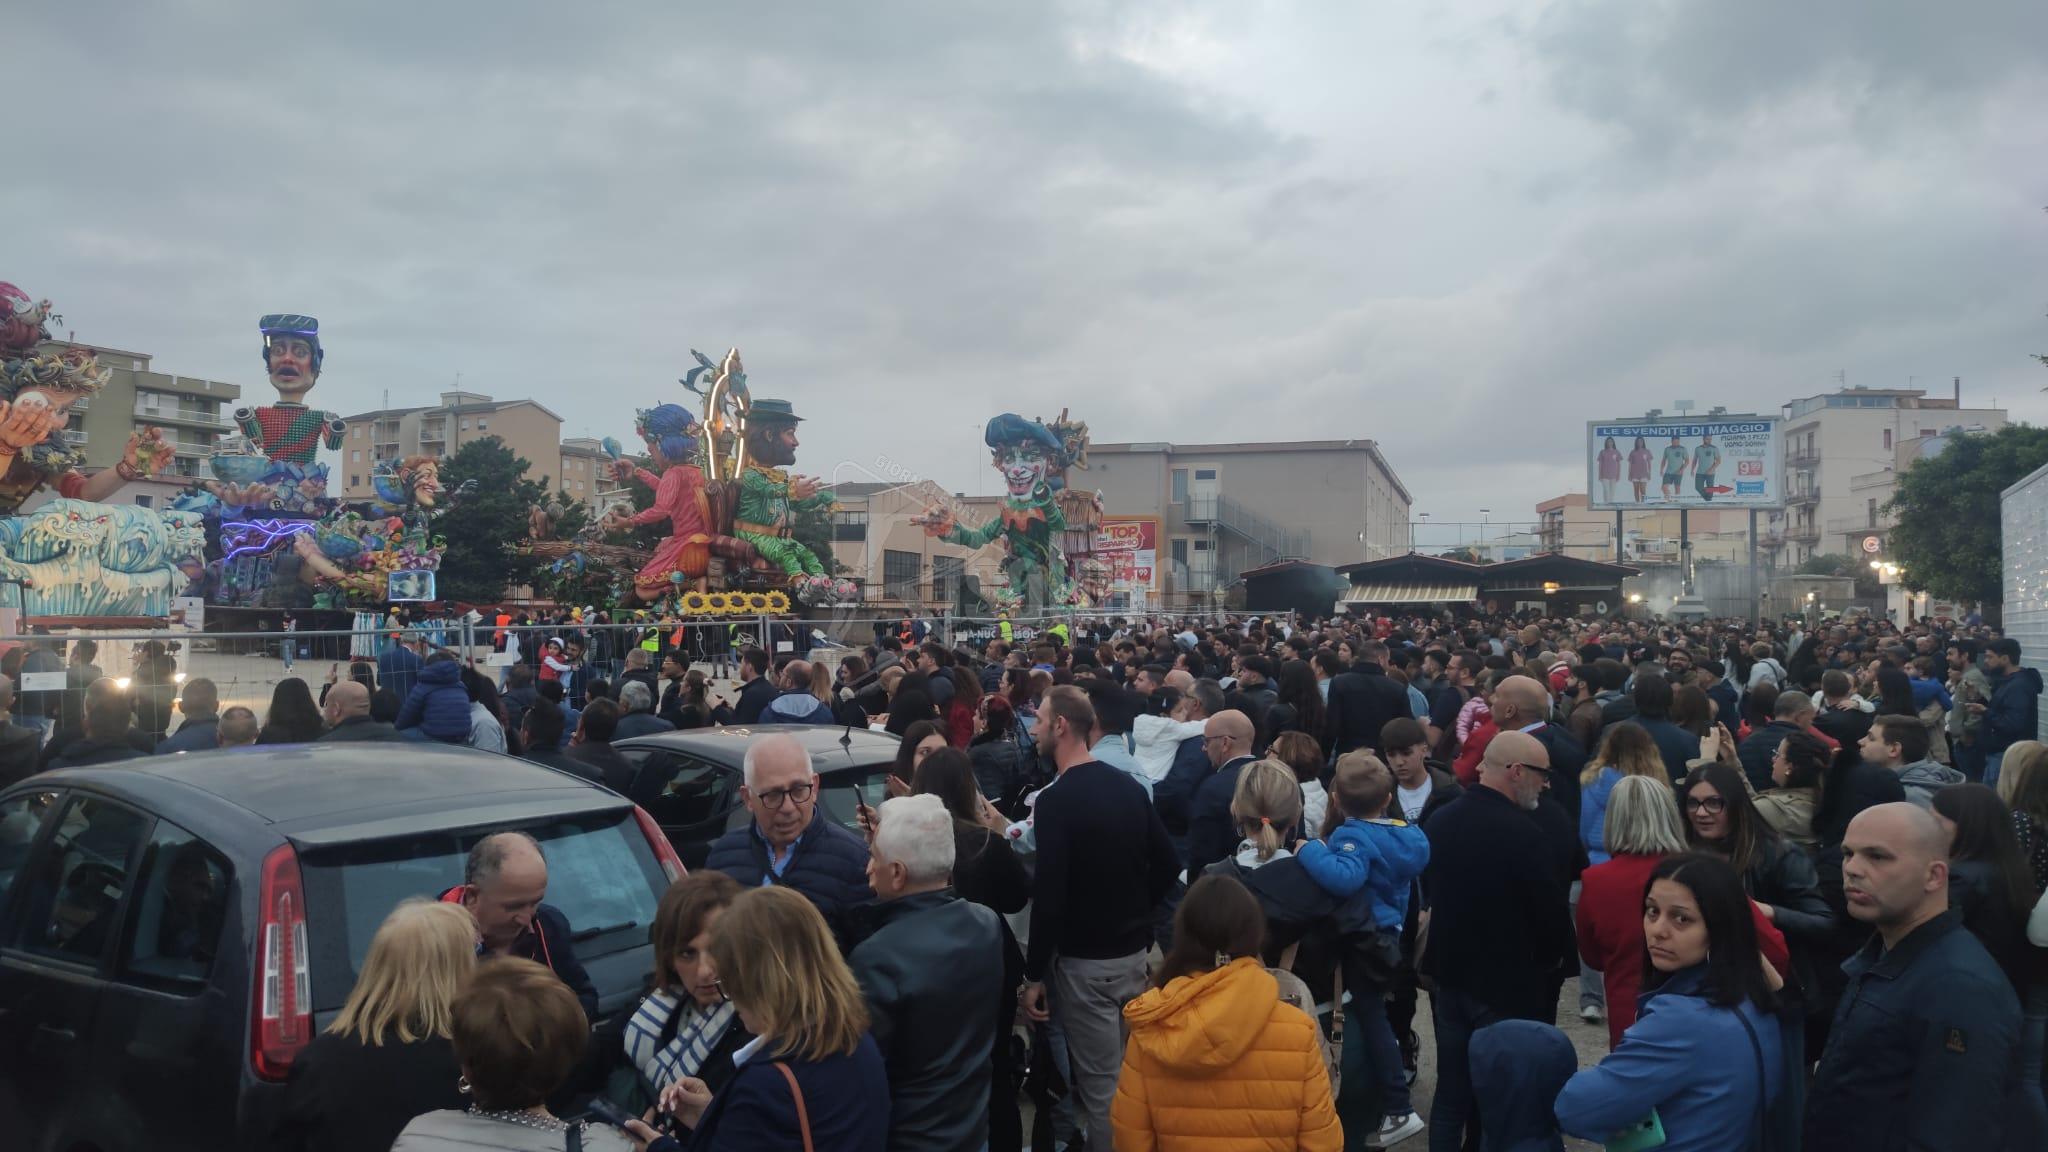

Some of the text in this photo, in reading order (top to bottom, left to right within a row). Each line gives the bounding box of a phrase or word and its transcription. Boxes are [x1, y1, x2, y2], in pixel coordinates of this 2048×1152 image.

[1623, 426, 1688, 436] SVENDITE
[1691, 426, 1705, 435] DI
[1708, 424, 1765, 435] MAGGIO
[1110, 526, 1138, 538] TOP
